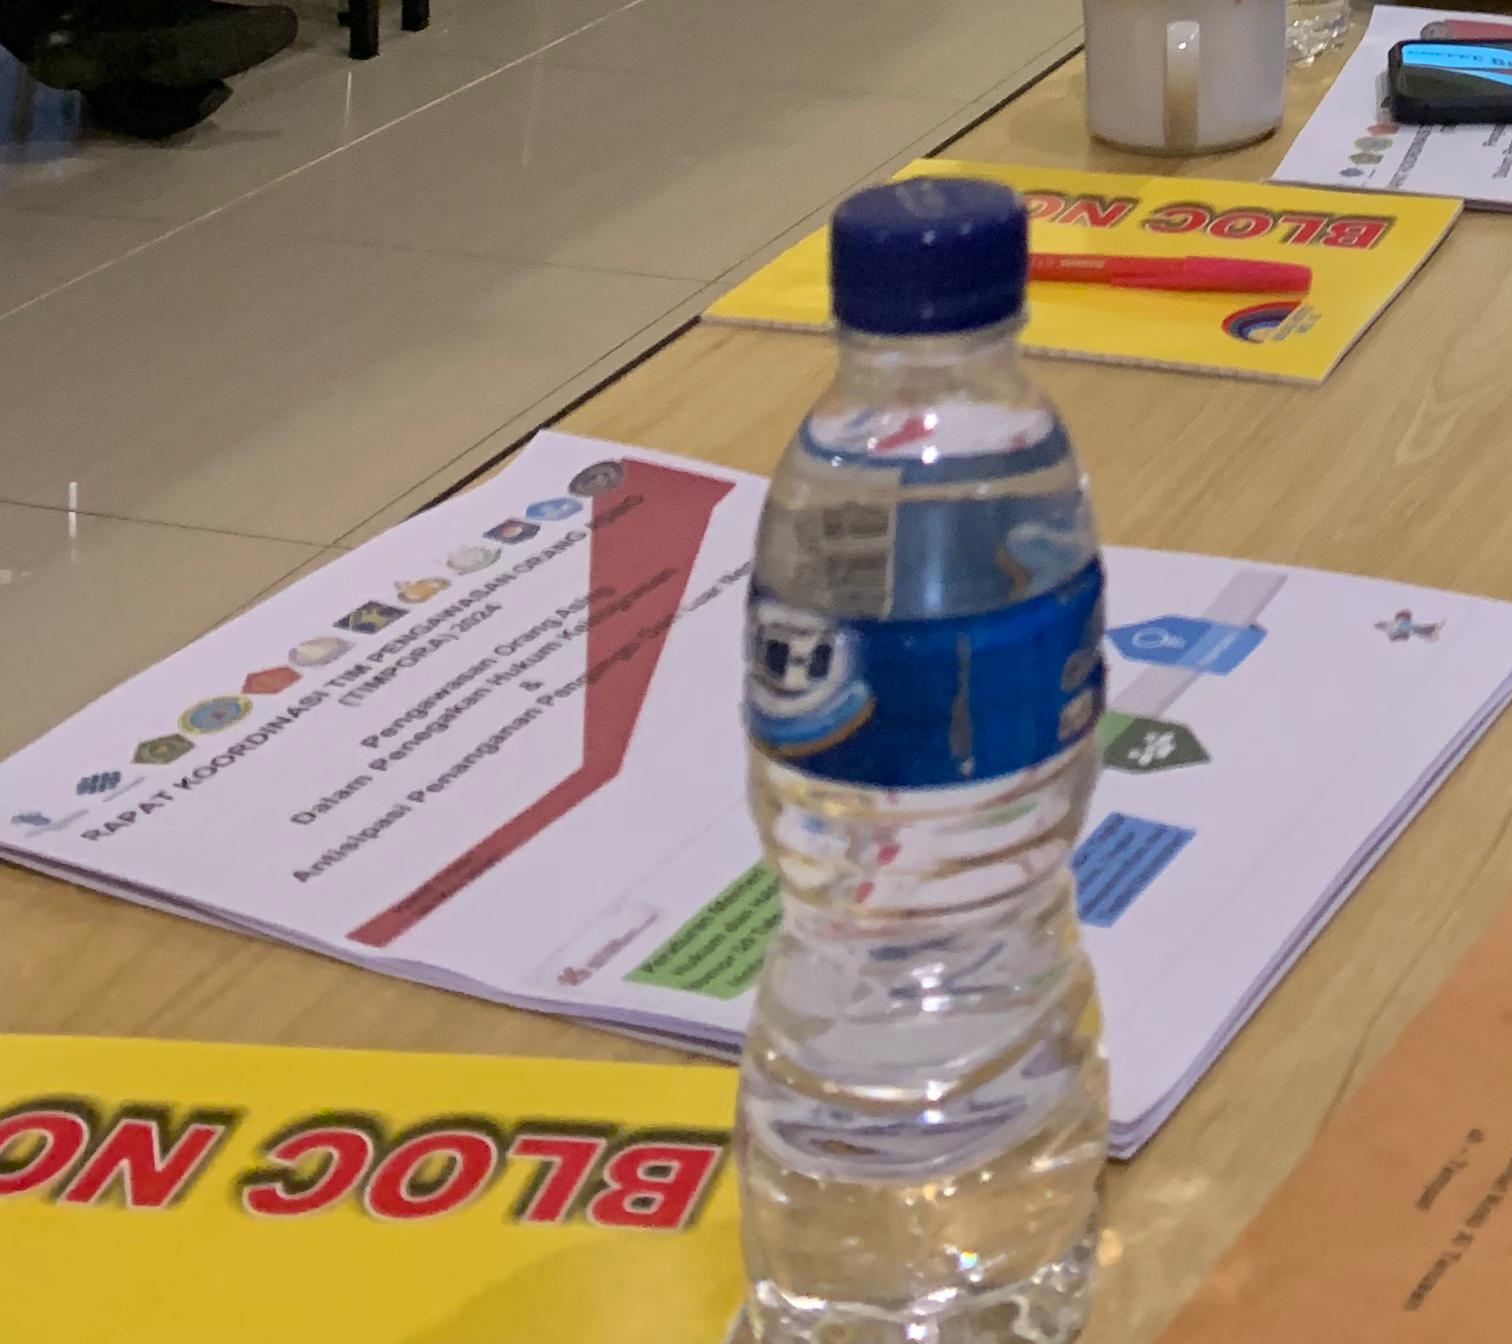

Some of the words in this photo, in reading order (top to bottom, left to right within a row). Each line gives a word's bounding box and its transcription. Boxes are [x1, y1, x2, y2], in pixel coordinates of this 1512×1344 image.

[1144, 206, 1391, 251] BLOC
[80, 790, 174, 841] RAPAT
[173, 690, 331, 790] KOORDINASI
[324, 663, 372, 689] TIM
[367, 573, 517, 663] PENGAWASAN
[512, 530, 588, 574] ORANG
[337, 623, 460, 708] (TIMPORA)
[458, 602, 503, 634] 2024
[360, 657, 498, 749] Pengawasan
[494, 616, 564, 658] Orang
[290, 775, 374, 825] Dalam
[368, 687, 491, 771] Penegakan
[486, 641, 562, 688] Hukum
[293, 803, 413, 883] Antisipasi
[406, 707, 544, 803] Penanganan
[242, 1123, 725, 1232] BLOC
